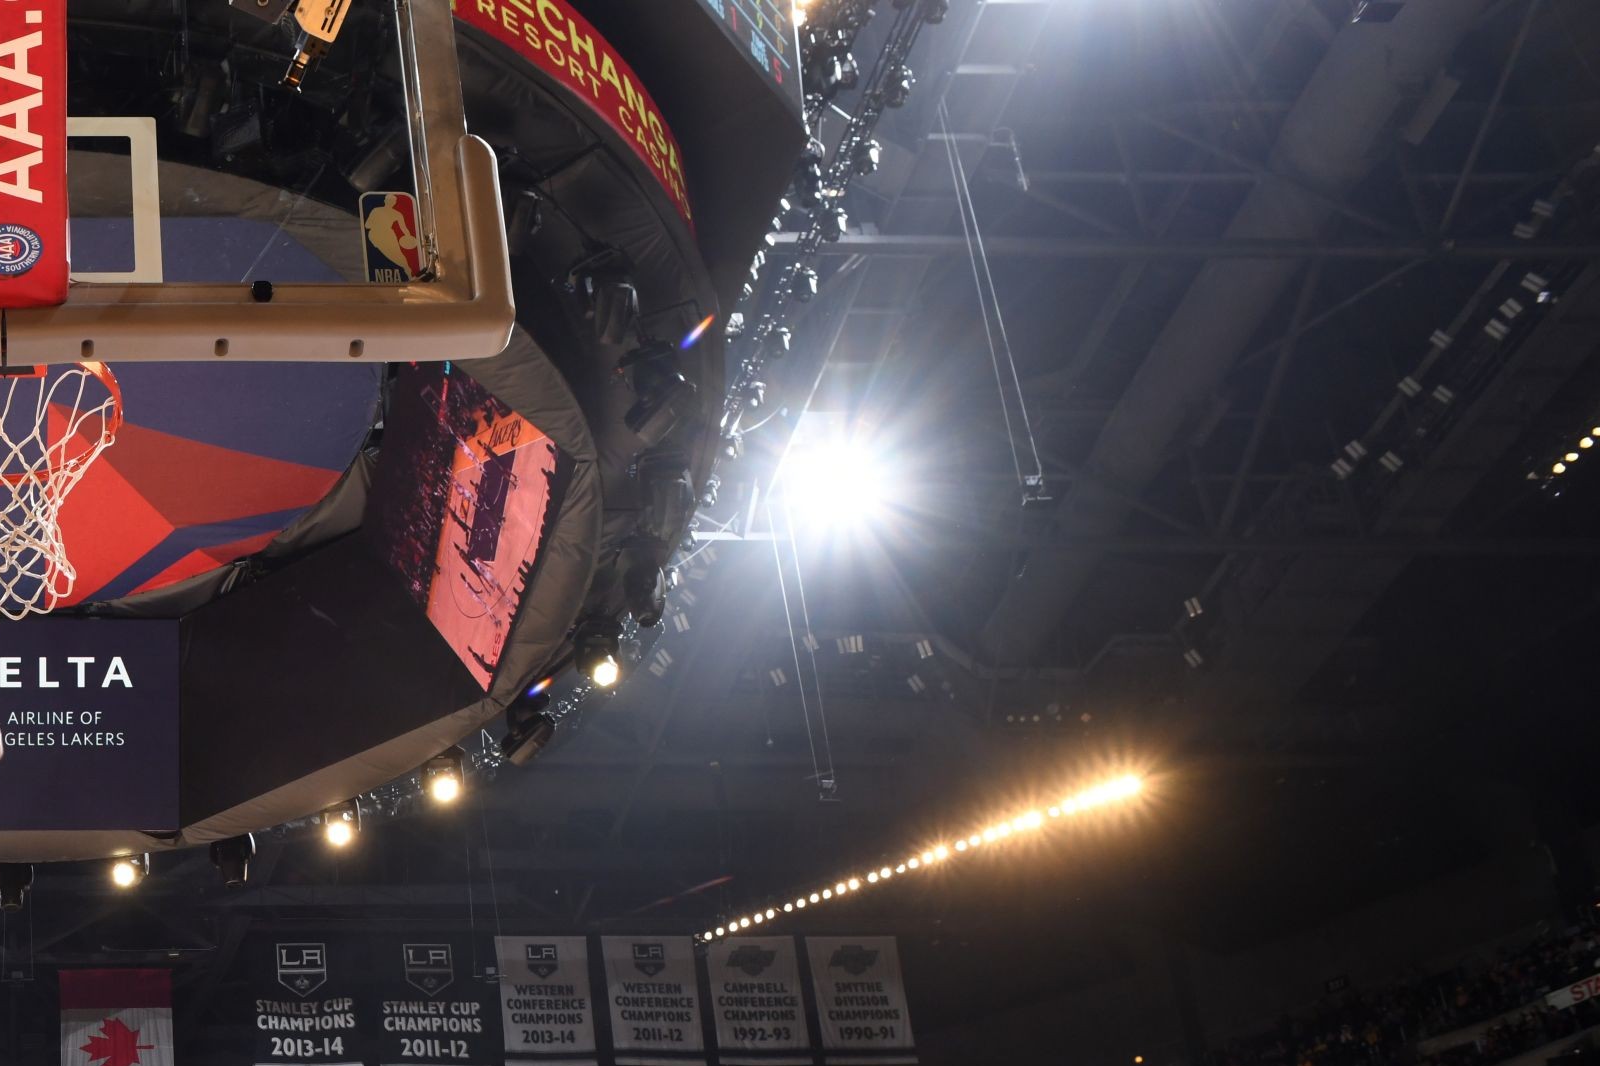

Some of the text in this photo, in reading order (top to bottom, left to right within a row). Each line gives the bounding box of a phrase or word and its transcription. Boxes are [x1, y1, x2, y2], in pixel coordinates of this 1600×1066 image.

[477, 0, 601, 98] RESORT
[5, 225, 40, 272] SOUTHERN CALIFORNIA
[373, 268, 402, 283] NBA
[0, 656, 133, 688] ELTA
[7, 711, 74, 725] AIRLINE
[80, 711, 102, 725] OF
[3, 732, 125, 746] GELES LAKERS
[514, 984, 575, 996] WESTERN
[623, 982, 682, 995] WESTERN
[724, 982, 788, 994] CAMPBELL
[835, 982, 883, 993] SMYTHE
[256, 998, 353, 1015] STANLEY CUP
[383, 1001, 480, 1016] STANLEY CUP
[506, 998, 586, 1010] CONFERENCE
[615, 996, 694, 1009] CONFERENCE
[718, 996, 798, 1008] CONFERENCE
[835, 996, 889, 1007] DIVISION
[512, 1013, 583, 1025] CHAMPIONS
[620, 1010, 692, 1023] CHAMPIONS
[724, 1010, 796, 1022] CHAMPIONS
[828, 1009, 900, 1021] CHAMPIONS
[257, 1013, 355, 1032] CHAMPIONS
[384, 1016, 482, 1033] CHAMPIONS
[522, 1030, 576, 1044] 2013-14
[633, 1027, 683, 1042] 2011-12
[733, 1027, 791, 1041] 1992-93
[839, 1026, 895, 1041] 1990-91
[271, 1036, 344, 1057] 2013-14
[400, 1038, 470, 1058] 2011-12
